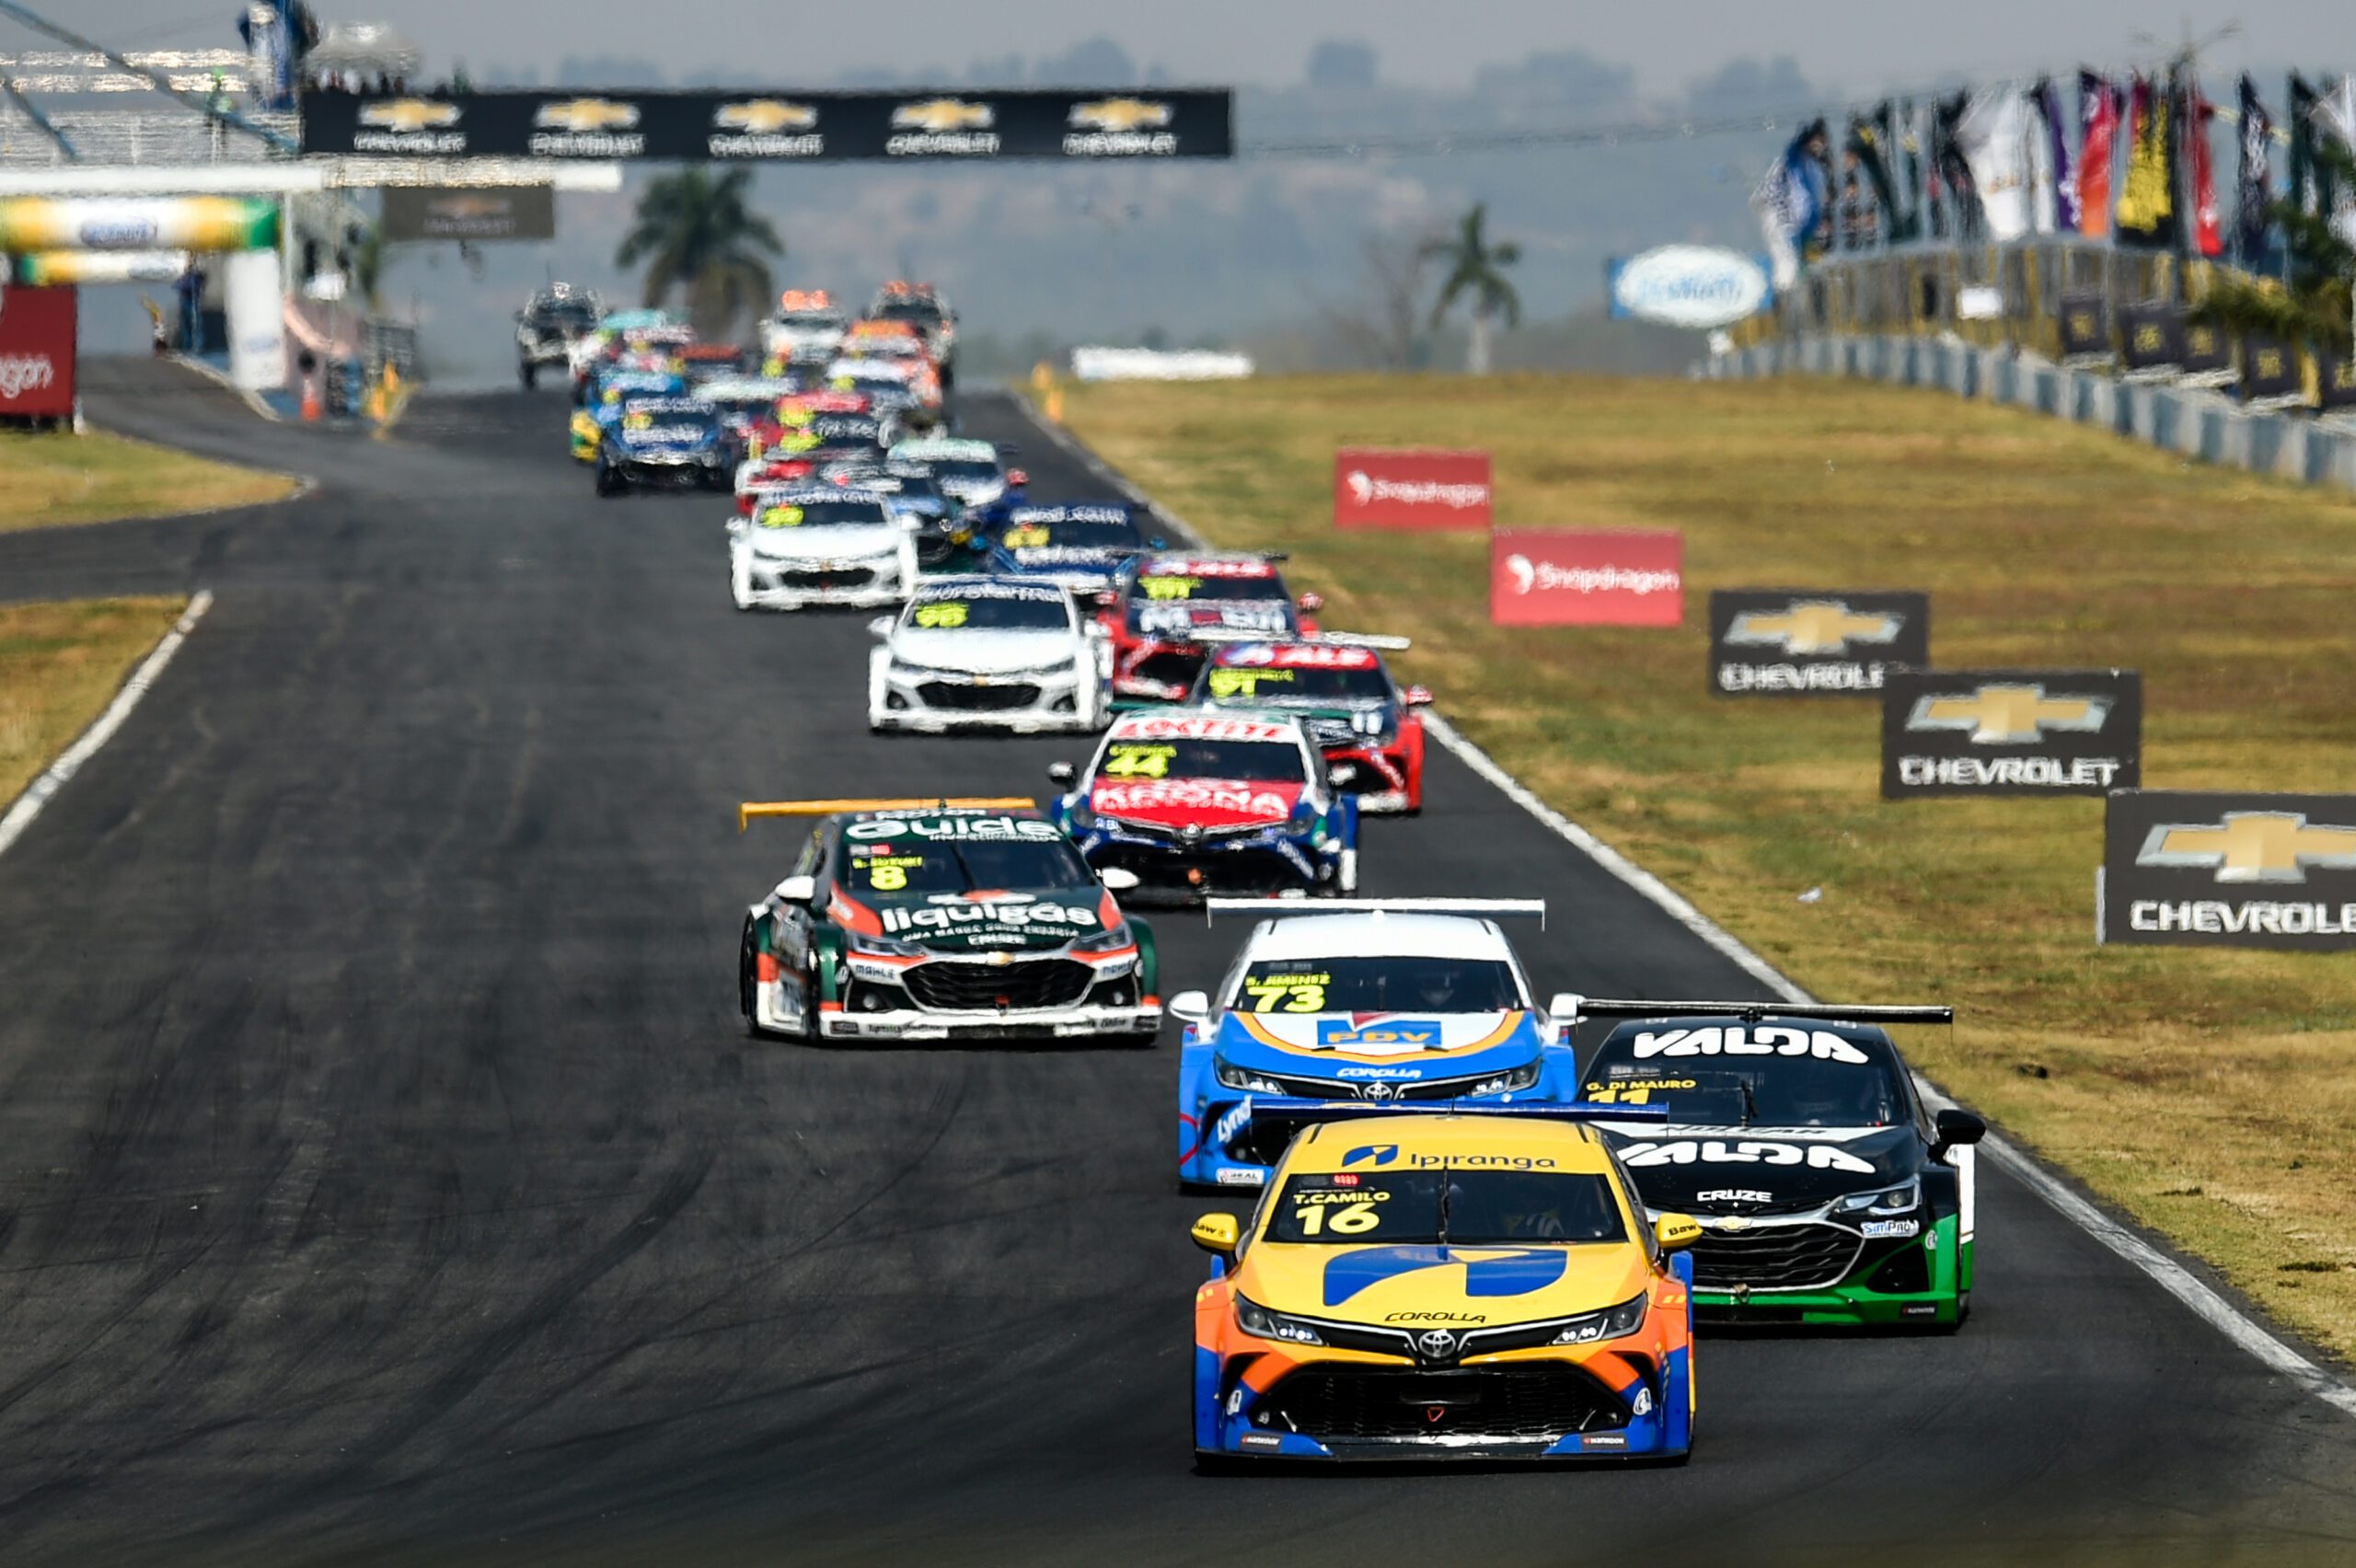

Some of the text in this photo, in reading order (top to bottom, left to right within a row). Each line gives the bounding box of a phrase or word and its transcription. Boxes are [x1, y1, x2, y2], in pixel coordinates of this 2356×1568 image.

[1534, 560, 1680, 594] Snapdragon
[1718, 660, 1885, 691] CHEVROLE
[1899, 755, 2120, 787] CHEVROLET
[870, 866, 907, 891] 8
[2130, 900, 2356, 934] CHEVROLE
[1247, 985, 1325, 1013] 73
[1327, 1032, 1432, 1043] PDV
[1634, 1027, 1869, 1064] VALDA
[1336, 1067, 1422, 1079] COROLLA
[1609, 1081, 1626, 1090] DI
[1630, 1079, 1697, 1090] MAURO
[1411, 1153, 1555, 1170] Ipiranga
[1293, 1191, 1391, 1205] T.CAMILO
[1697, 1190, 1773, 1203] CRUZE
[1296, 1201, 1380, 1235] 16
[1384, 1311, 1486, 1323] COROLLA
